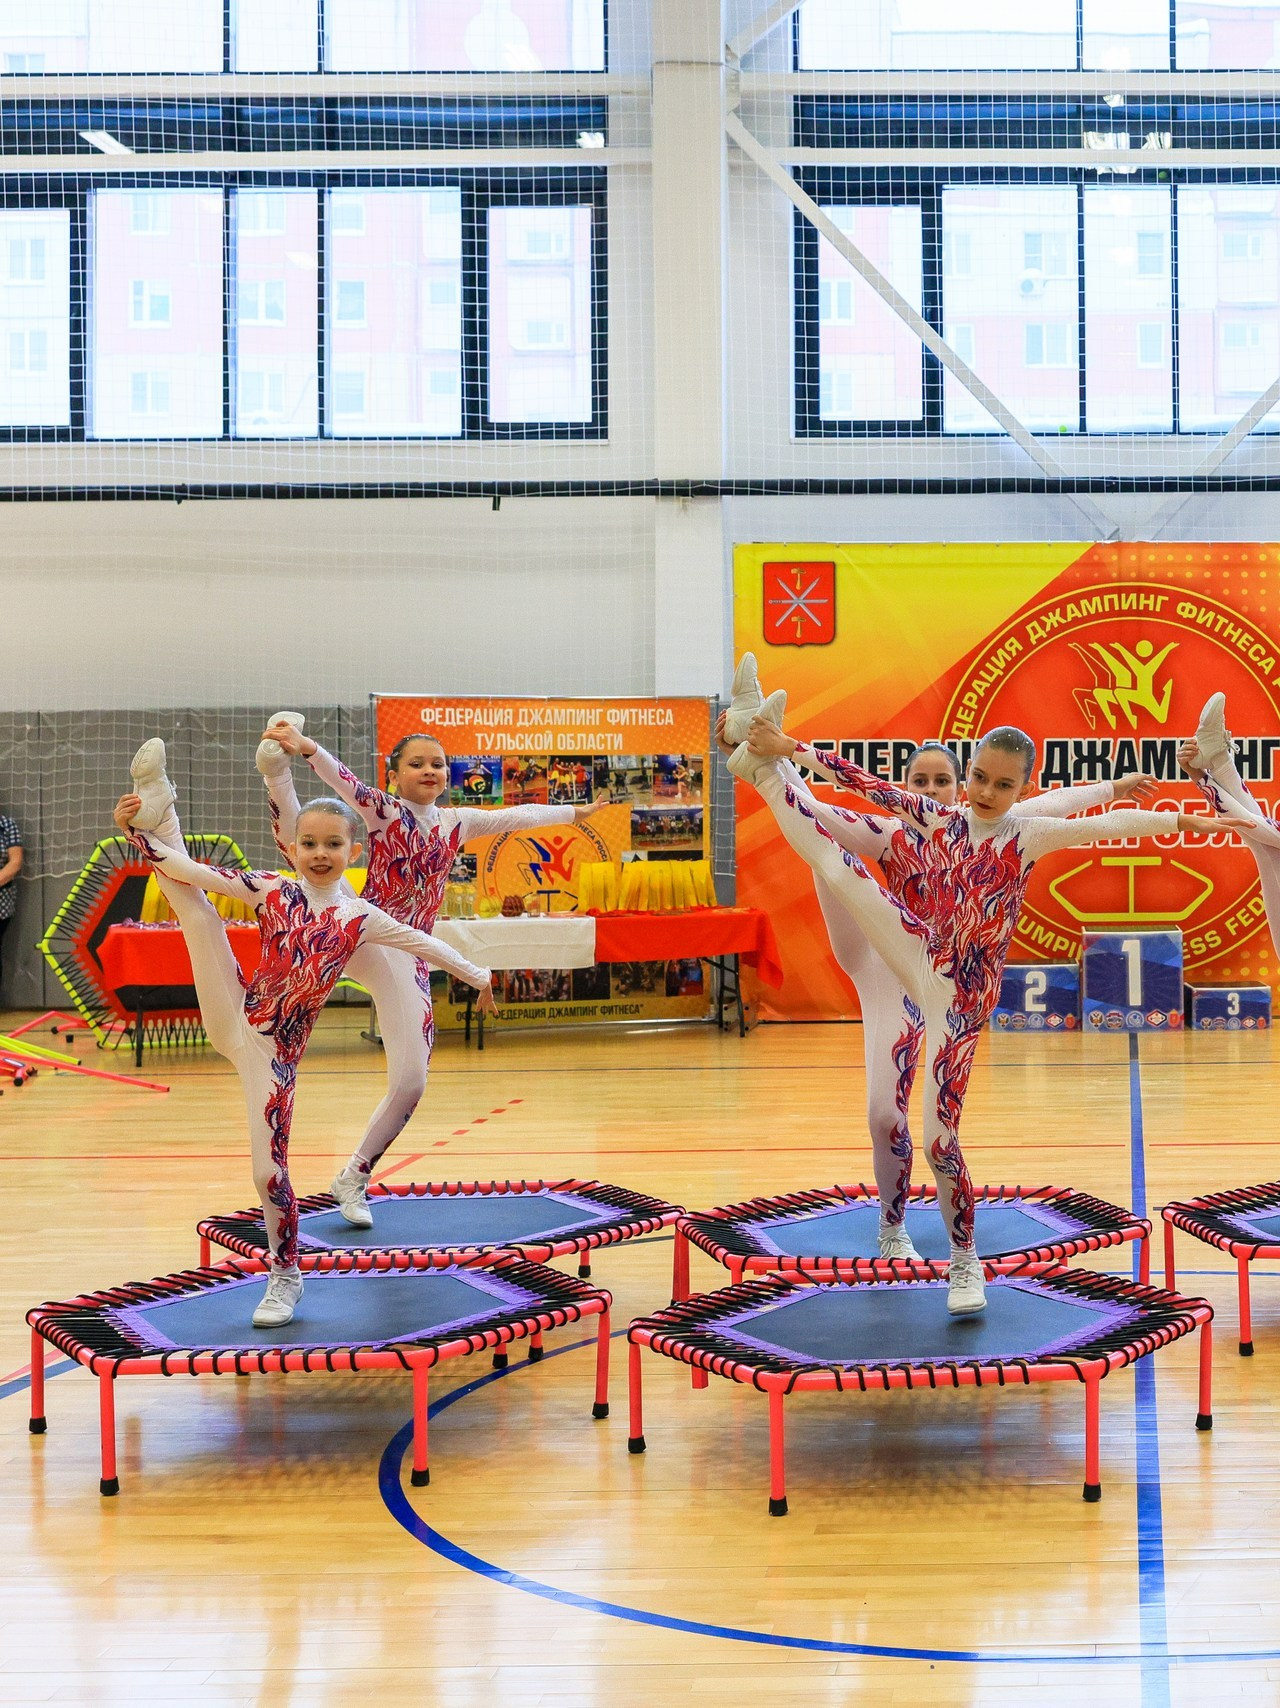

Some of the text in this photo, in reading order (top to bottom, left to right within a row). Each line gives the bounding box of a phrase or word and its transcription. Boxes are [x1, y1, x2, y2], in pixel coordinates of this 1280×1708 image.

[951, 637, 1024, 741] ДЕРАЦИЯ
[1025, 593, 1169, 645] ДЖАМПИНГ
[1176, 601, 1276, 676] ФИТНЕСА
[420, 707, 674, 728] ФЕДЕРАЦИЯ ДЖАМПИНГ ФИТНЕСА
[475, 730, 624, 751] ТУЛЬСКОЙ ОБЛАСТИ
[1121, 939, 1142, 1006] 1
[1025, 971, 1047, 1012] 2
[548, 1005, 598, 1019] ДЖАМПИНГ
[1227, 992, 1240, 1015] 3
